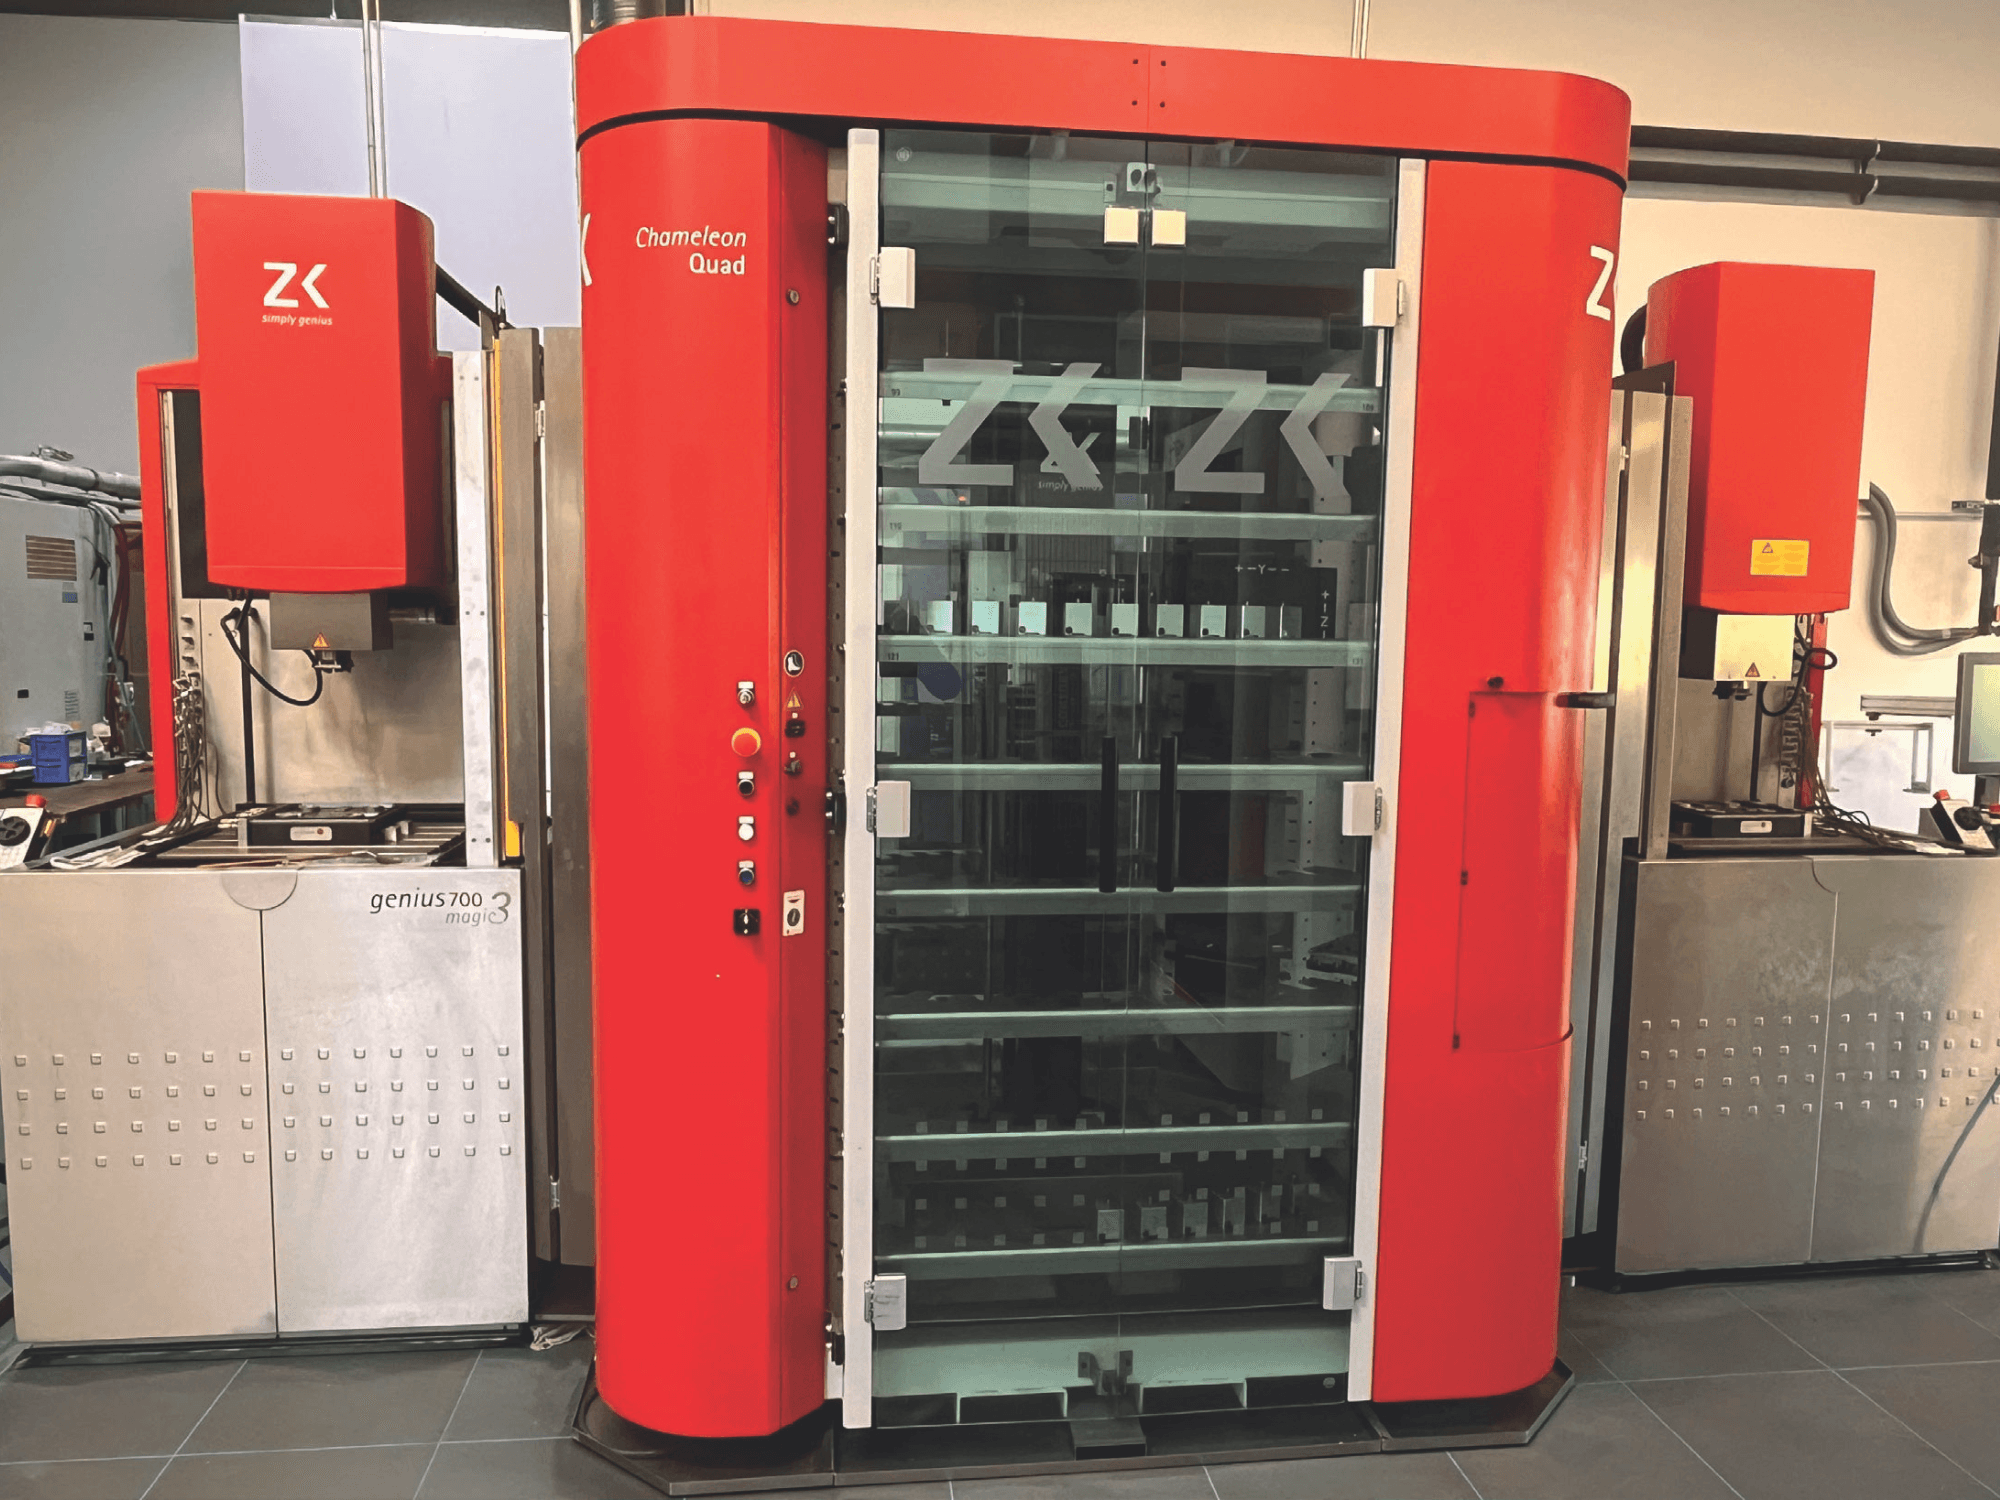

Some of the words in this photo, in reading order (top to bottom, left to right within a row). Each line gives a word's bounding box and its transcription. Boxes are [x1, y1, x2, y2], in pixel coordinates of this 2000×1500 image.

[636, 225, 747, 248] Chameleon
[689, 253, 745, 275] Quad
[263, 262, 330, 309] ZK
[1586, 245, 1615, 321] Z
[262, 314, 297, 326] simply
[298, 315, 333, 327] genius
